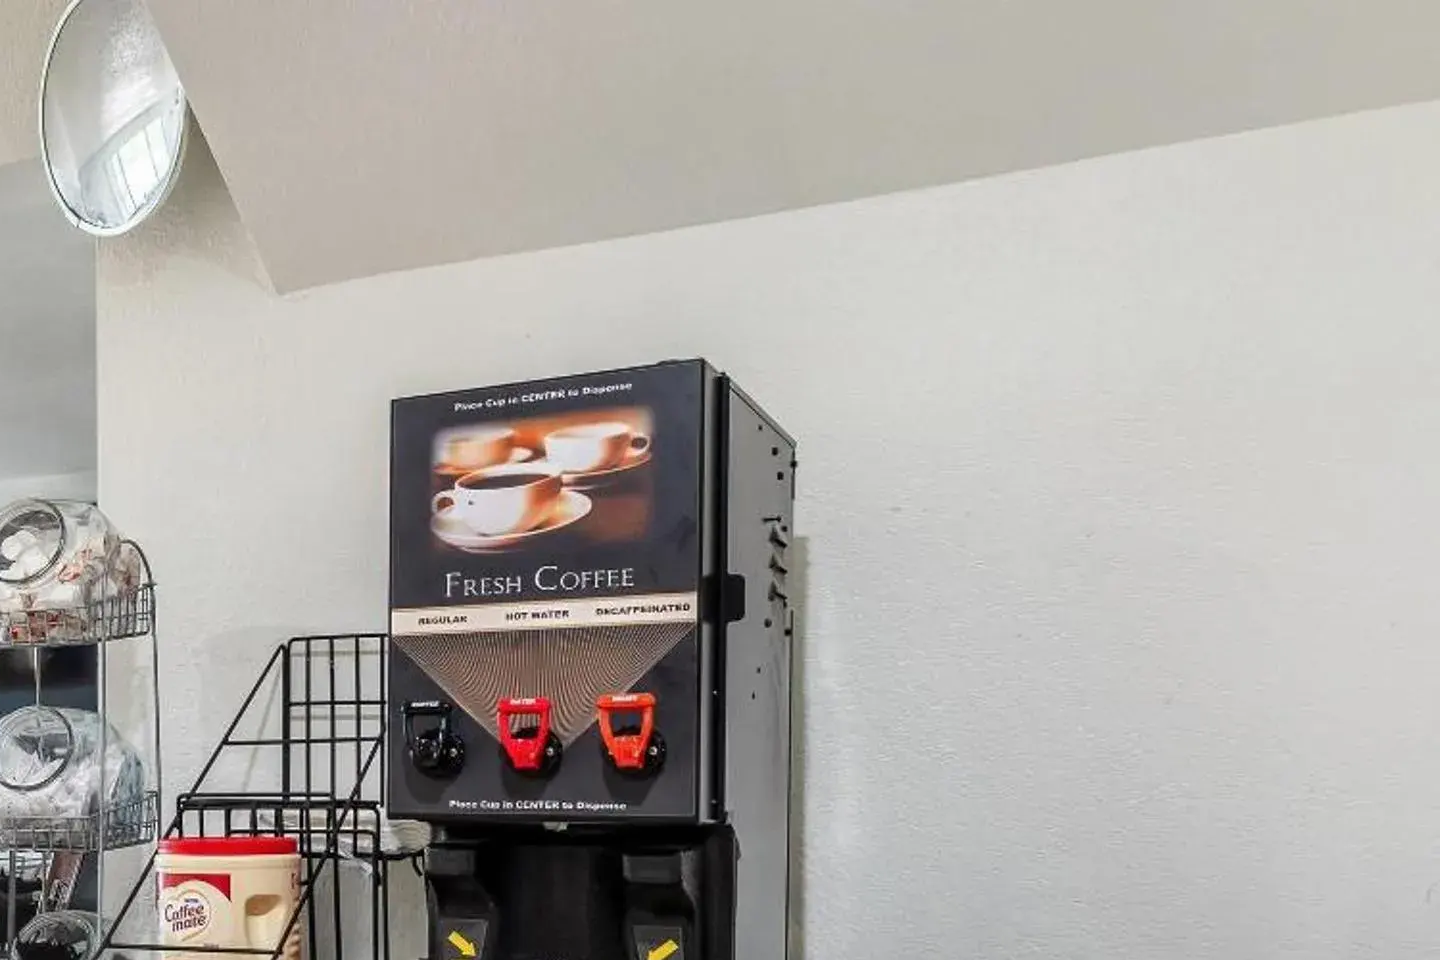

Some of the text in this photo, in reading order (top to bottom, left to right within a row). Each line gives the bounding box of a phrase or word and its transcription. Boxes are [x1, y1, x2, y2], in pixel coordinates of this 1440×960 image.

[485, 398, 506, 408] Cup
[521, 388, 566, 403] CENTER
[534, 565, 635, 591] COFFEE
[418, 603, 691, 626] REGULAR HOT WATER DECAFFEINATED
[479, 800, 501, 810] Cup
[502, 800, 514, 809] in
[515, 800, 560, 810] CENTER
[561, 801, 574, 810] to
[576, 801, 628, 812] Dispense
[164, 903, 205, 922] Coffee
[172, 915, 207, 932] mate
